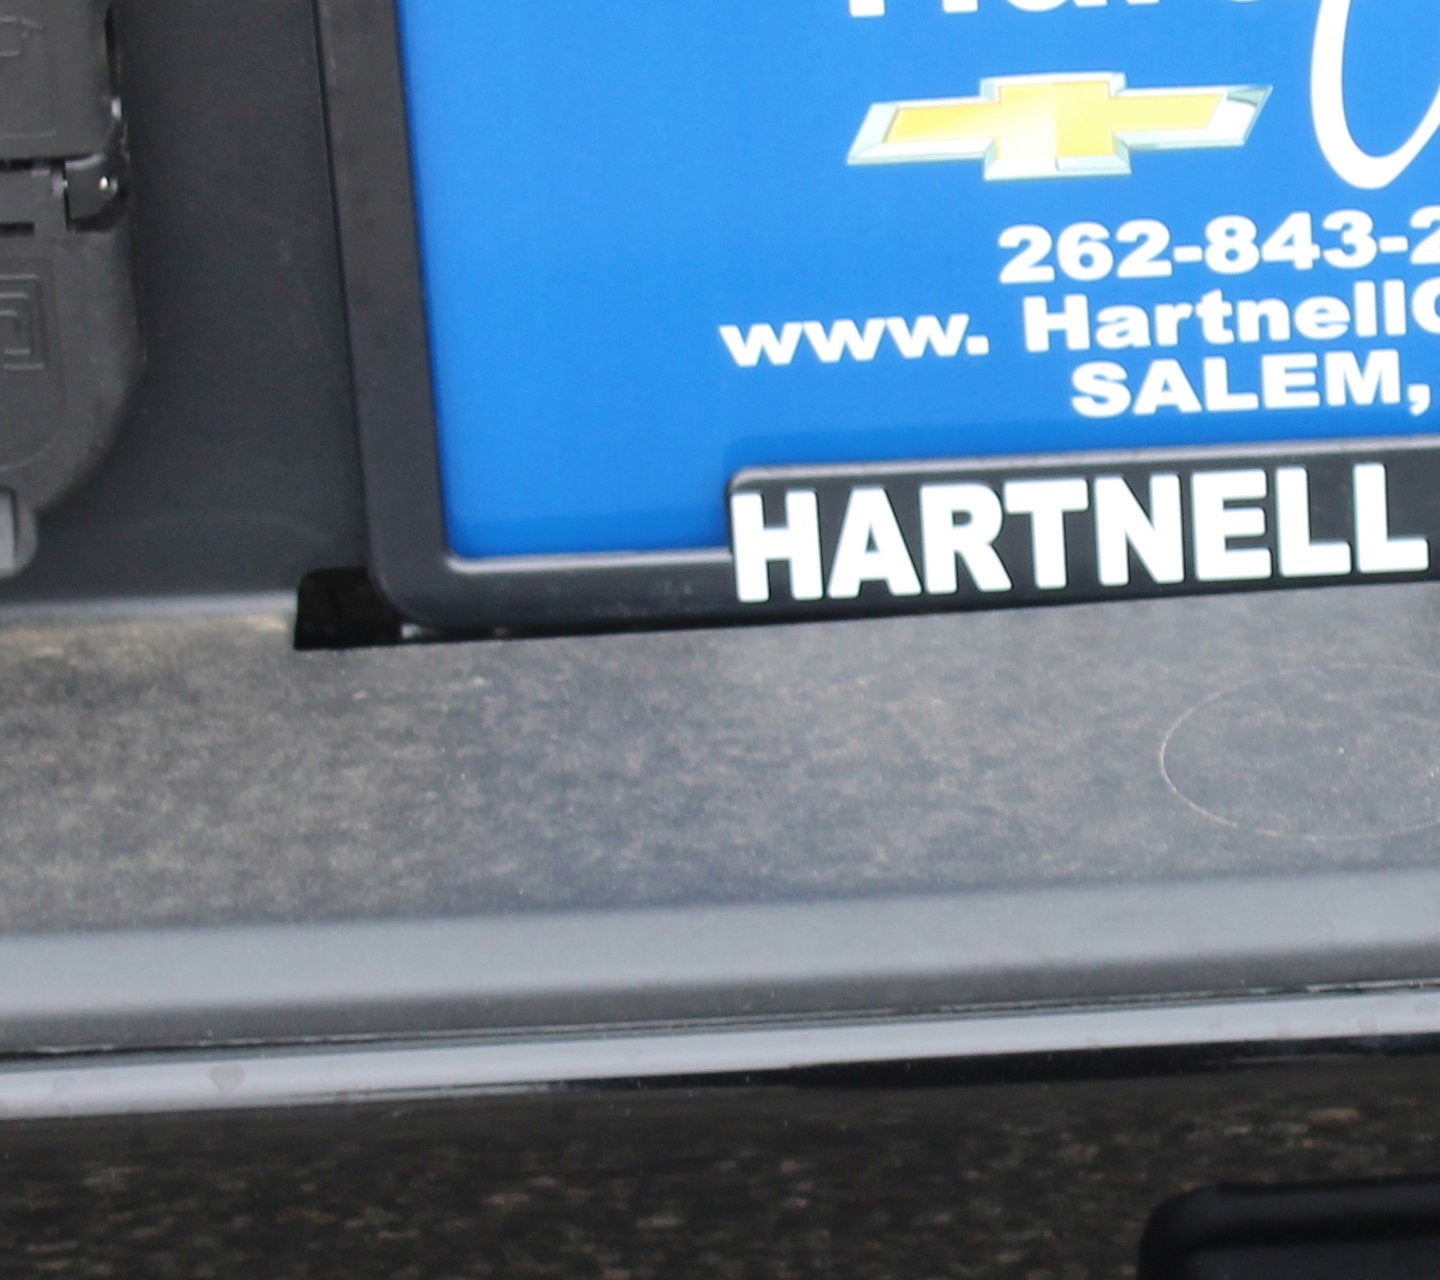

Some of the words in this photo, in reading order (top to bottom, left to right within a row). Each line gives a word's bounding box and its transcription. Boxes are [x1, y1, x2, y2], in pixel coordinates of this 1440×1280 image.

[720, 314, 989, 367] www.
[1071, 350, 1431, 418] SALEM,
[731, 463, 1429, 602] HARTNELL
